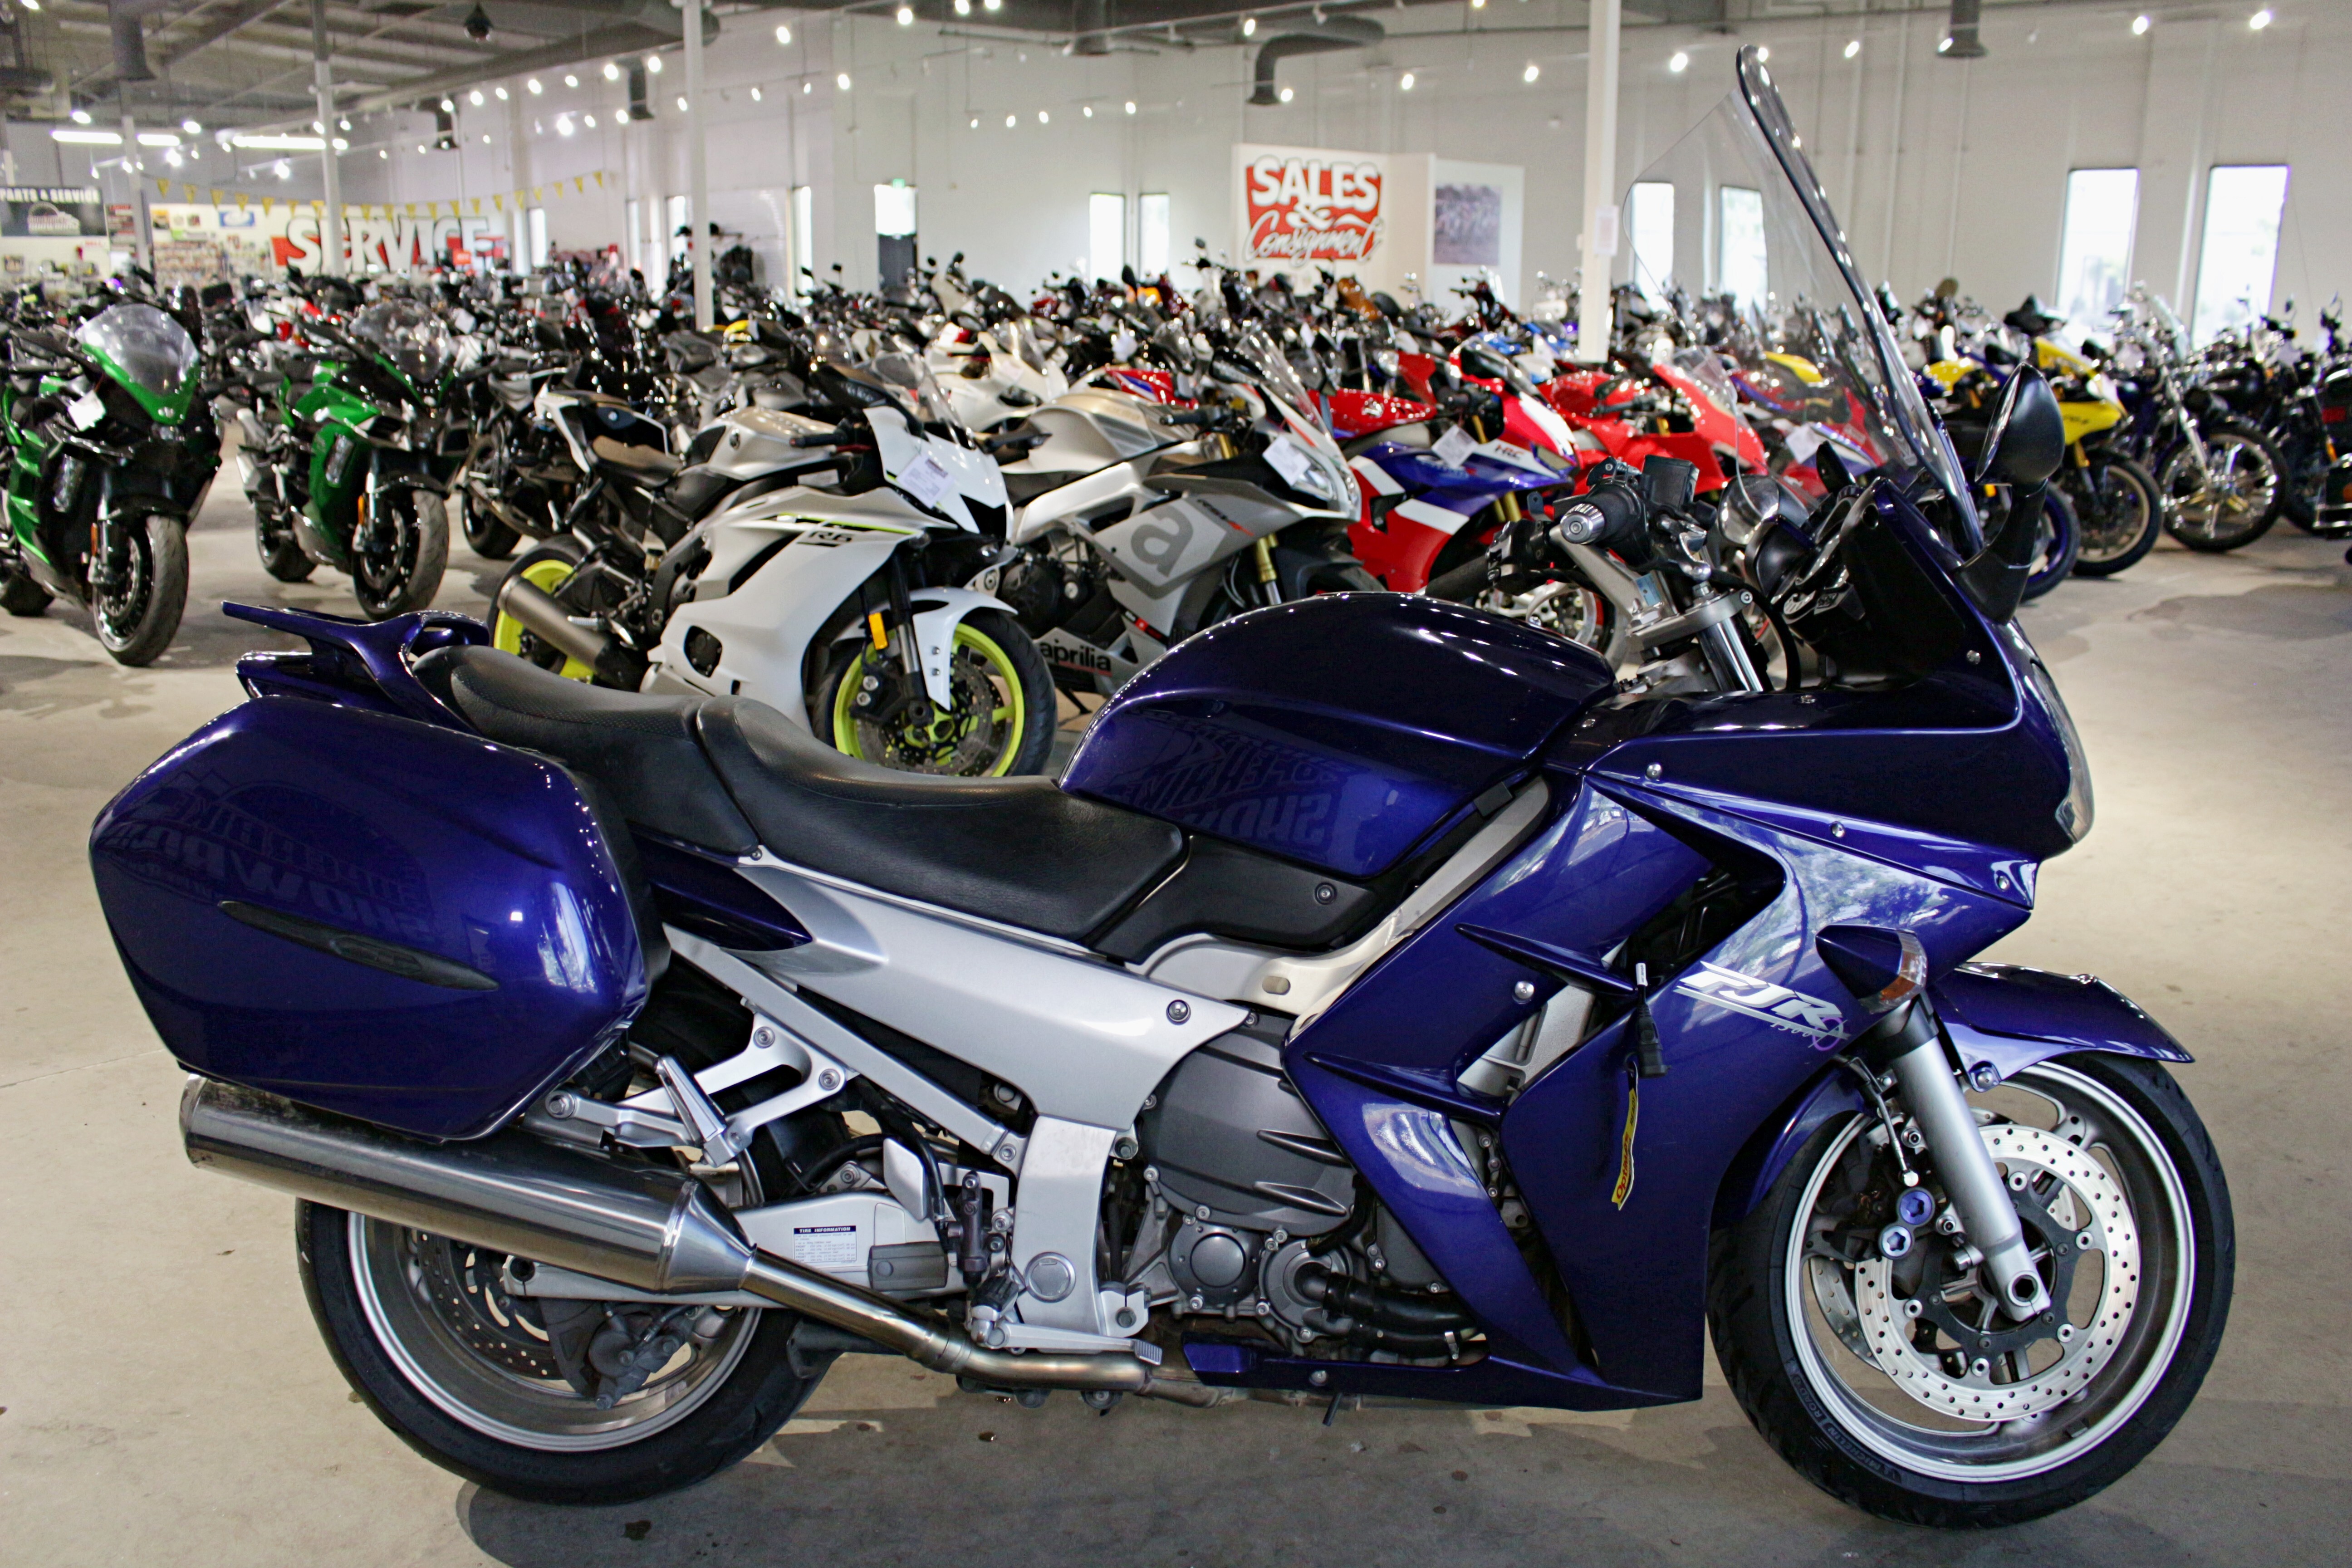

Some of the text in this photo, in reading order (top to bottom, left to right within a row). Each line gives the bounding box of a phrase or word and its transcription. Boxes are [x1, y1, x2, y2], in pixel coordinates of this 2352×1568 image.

[50, 188, 99, 203] SERVICE
[1251, 154, 1379, 211] SALES
[1285, 204, 1336, 230] &
[287, 215, 505, 275] SERVICE
[1243, 208, 1384, 269] Consignment
[1494, 444, 1524, 459] HRC
[808, 530, 853, 543] R6
[1039, 639, 1111, 671] aprilia
[1679, 961, 1842, 1030] FJR
[1799, 1387, 1823, 1418] ROAD
[1827, 1426, 1882, 1470] MICHELIN
